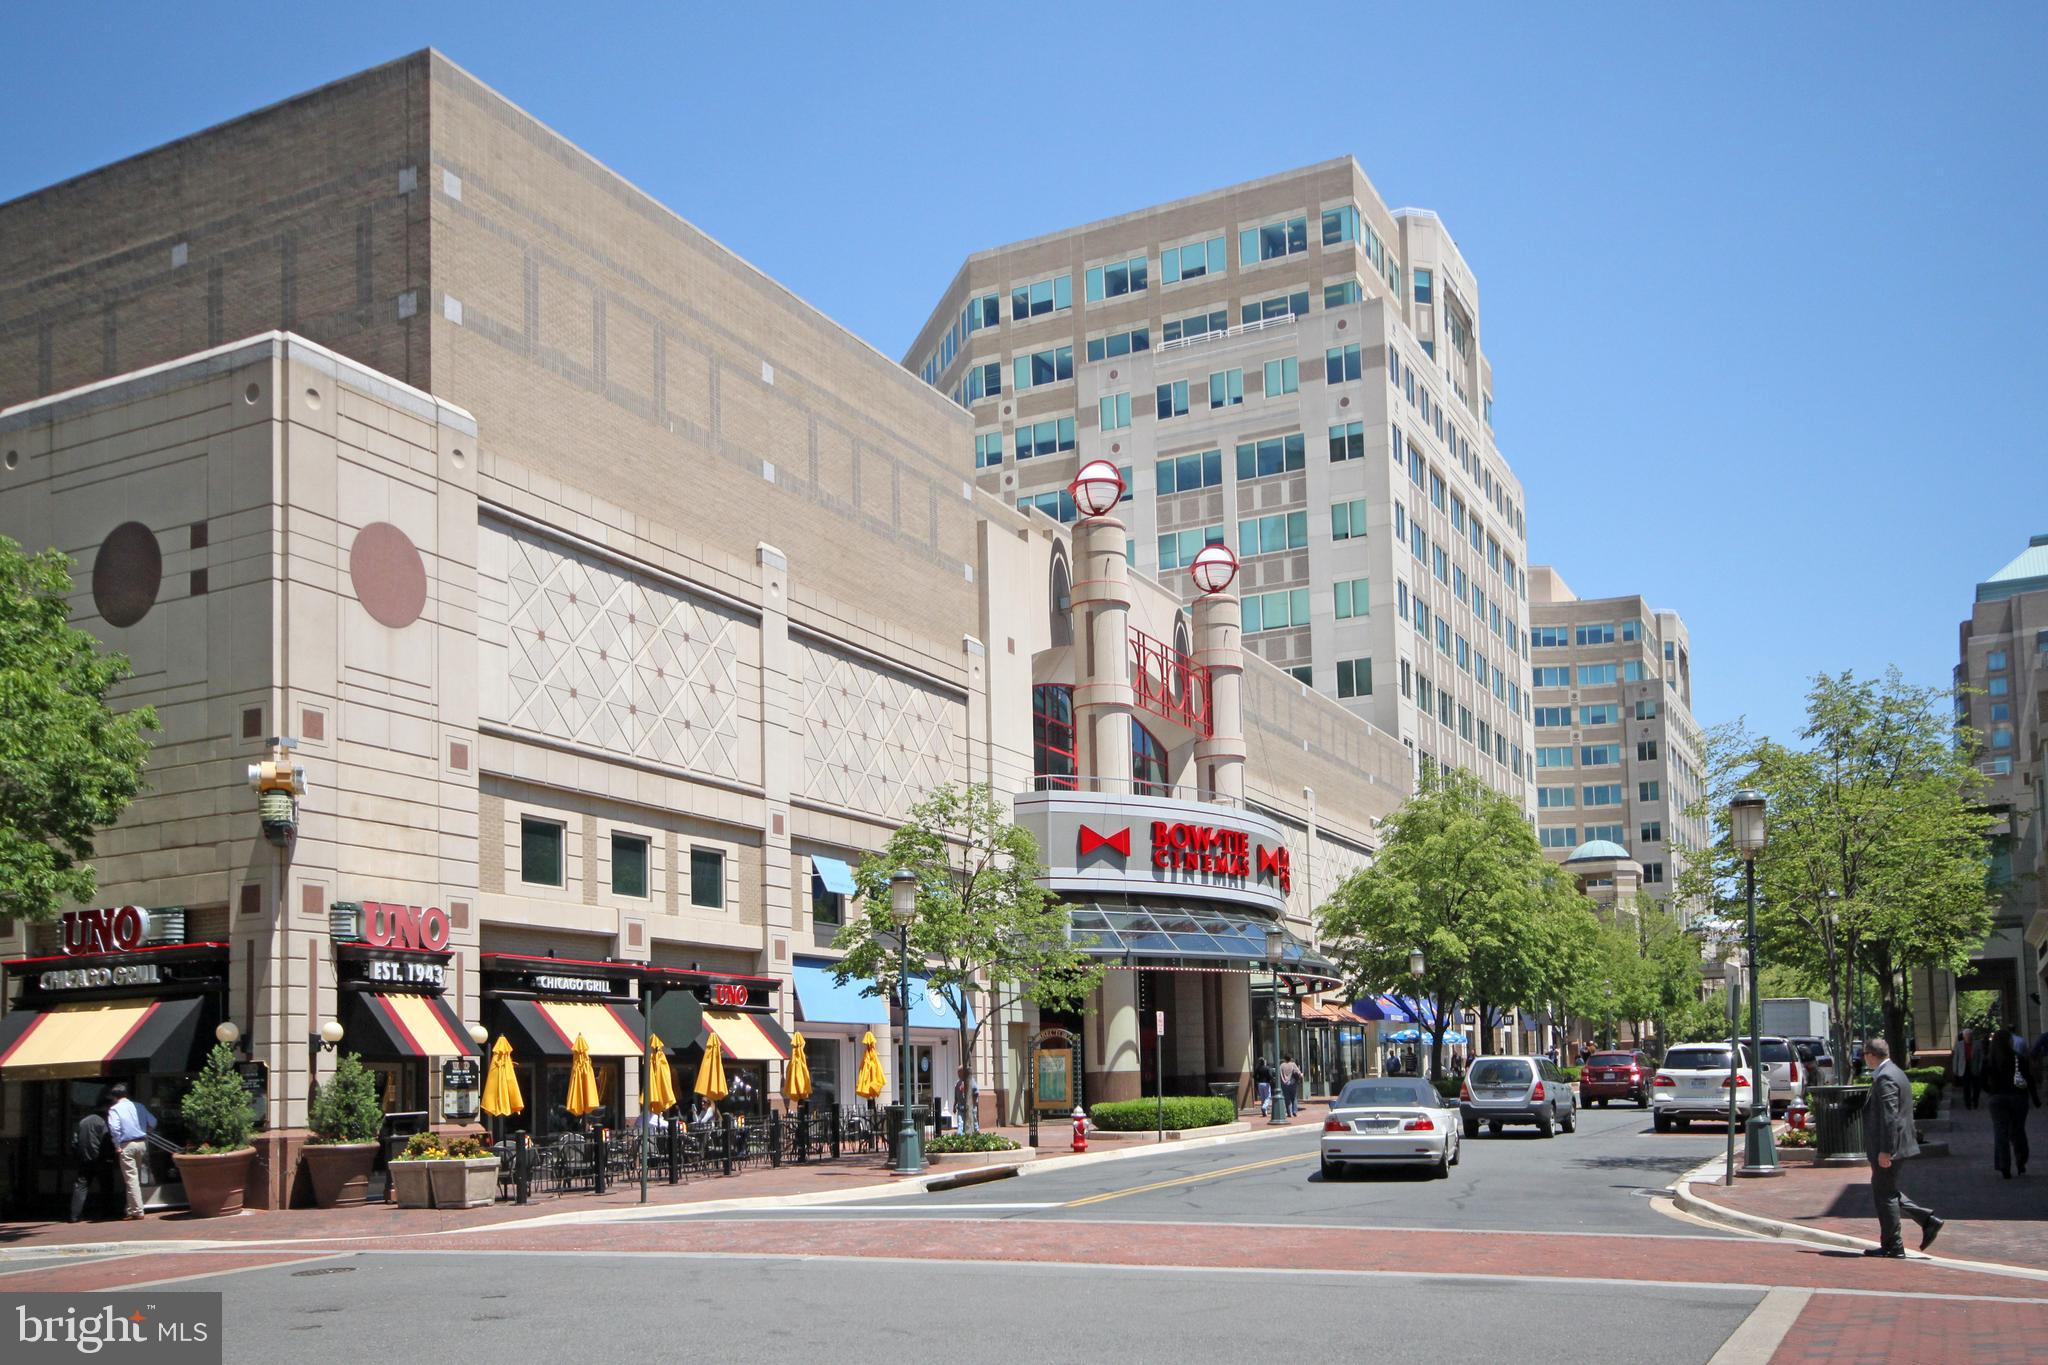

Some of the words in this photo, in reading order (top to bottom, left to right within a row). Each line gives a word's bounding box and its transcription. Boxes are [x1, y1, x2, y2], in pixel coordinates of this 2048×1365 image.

[1154, 850, 1250, 876] CINEMAS
[62, 905, 148, 956] UNO
[362, 901, 449, 951] UNO
[39, 967, 112, 990] CHICAGO
[112, 964, 161, 986] GRILL
[374, 961, 403, 981] EST.
[407, 963, 444, 983] 1943
[539, 976, 584, 991] CHICAGO
[586, 979, 611, 992] GRILL
[715, 984, 748, 1005] UNO
